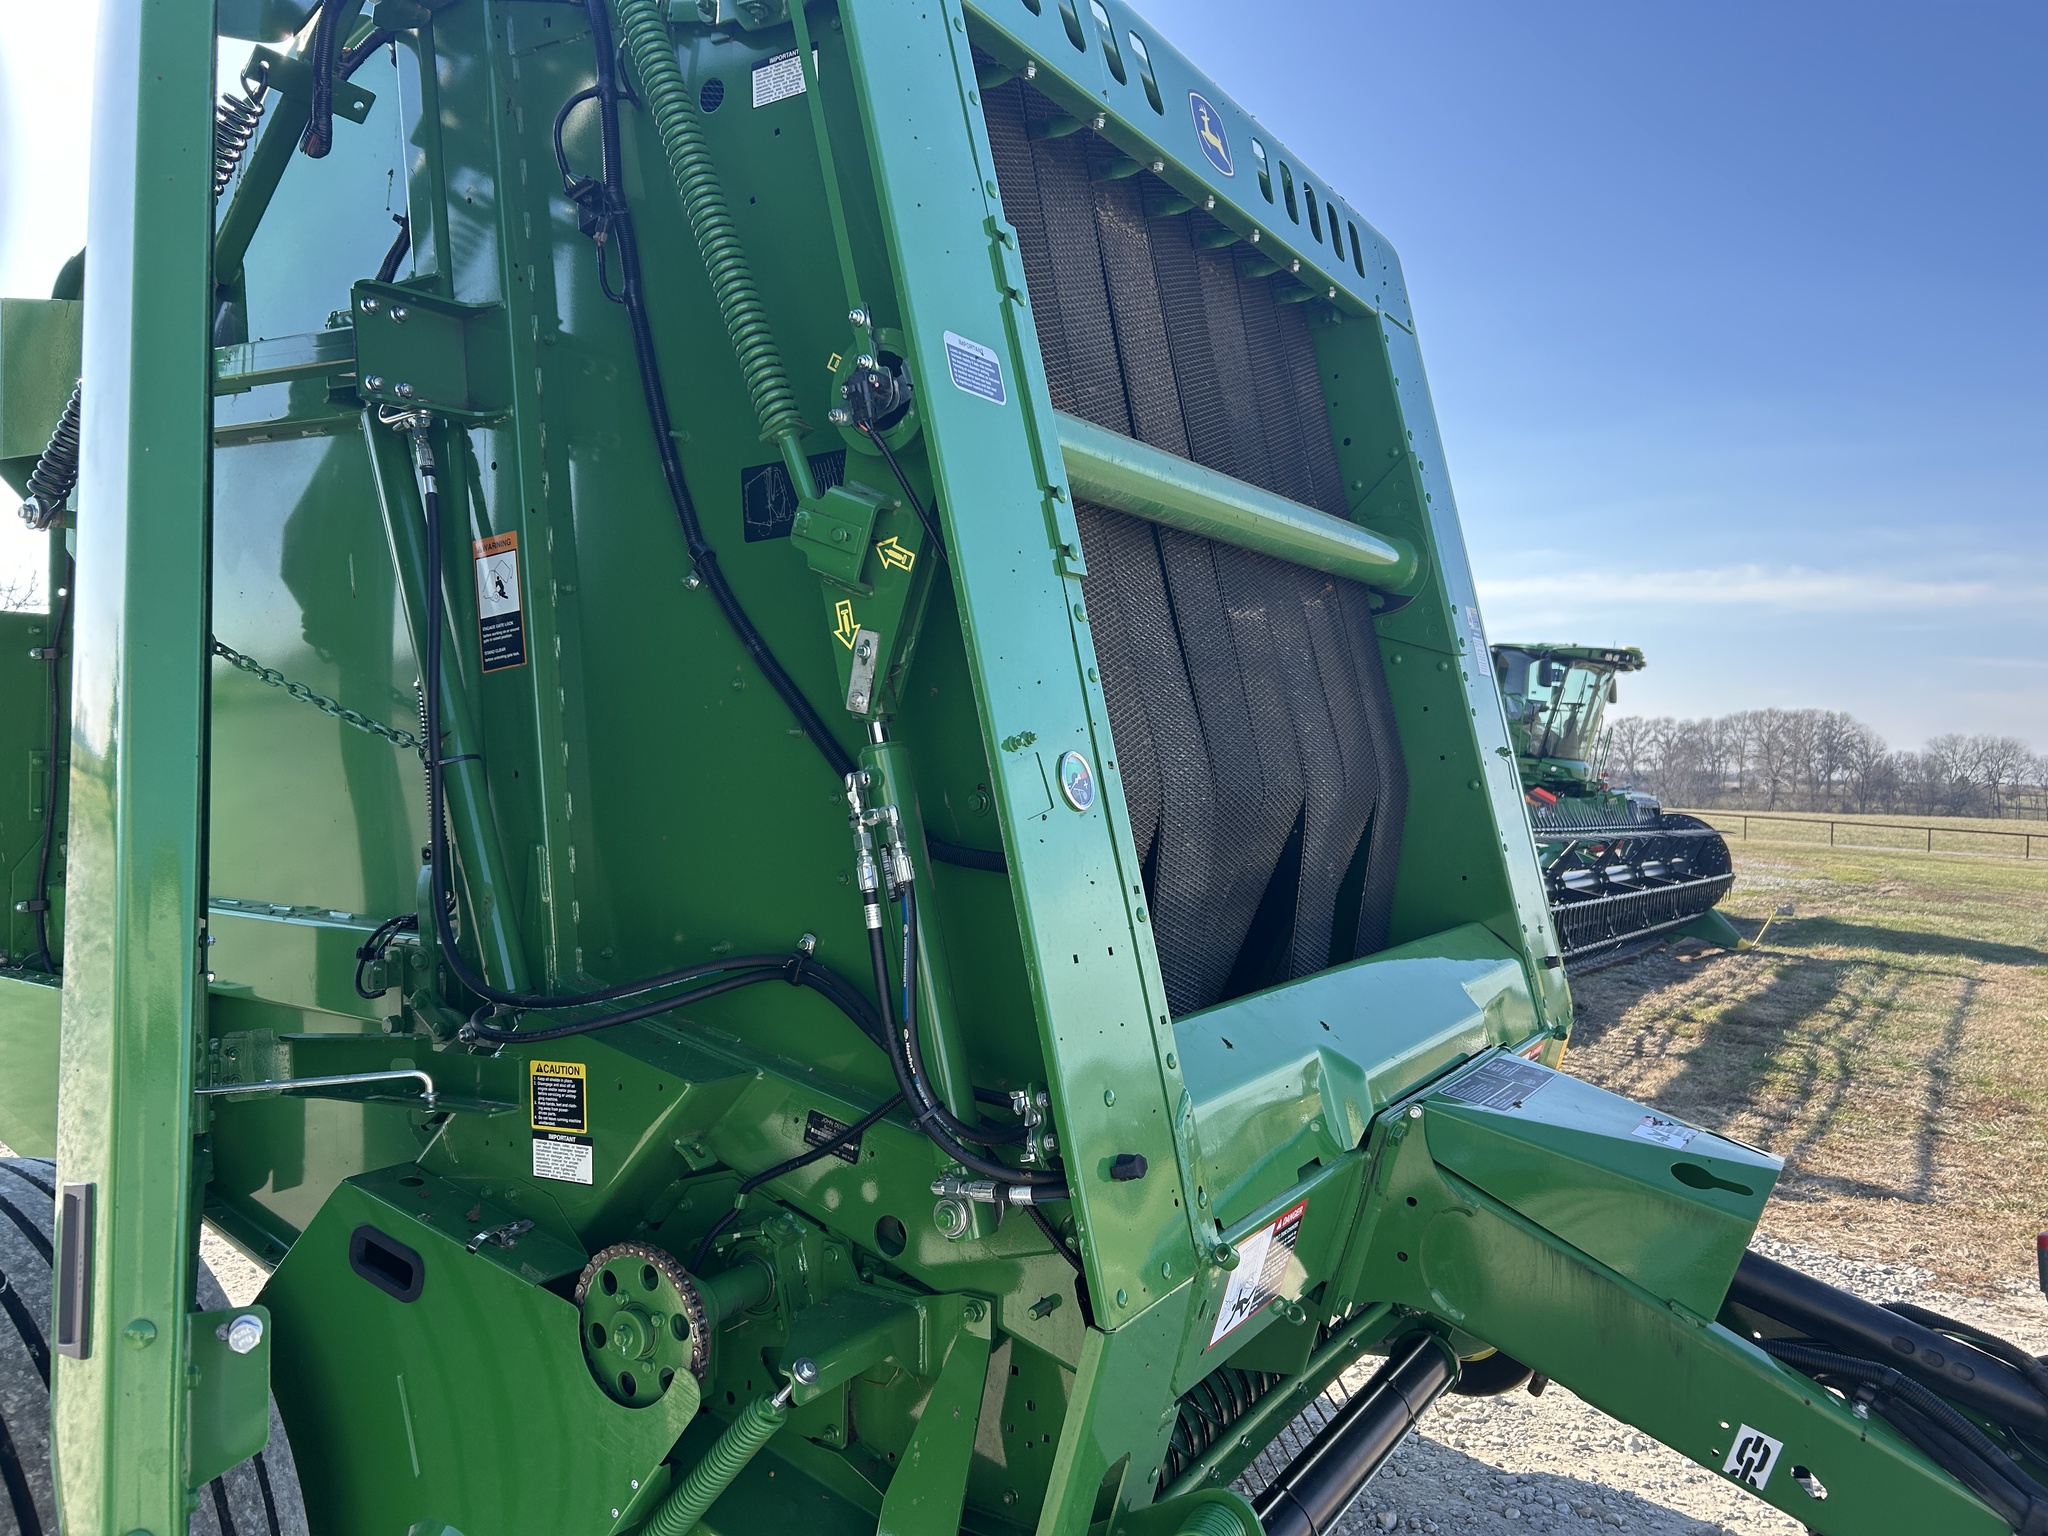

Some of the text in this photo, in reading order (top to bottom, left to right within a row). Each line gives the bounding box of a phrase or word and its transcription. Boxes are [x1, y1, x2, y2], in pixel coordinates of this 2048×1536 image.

[769, 49, 798, 64] IMPORTANT
[483, 538, 511, 551] WARNING
[544, 1064, 580, 1075] CAUTION
[548, 1134, 576, 1142] IMPORTANT
[1283, 1206, 1303, 1226] DANGER
